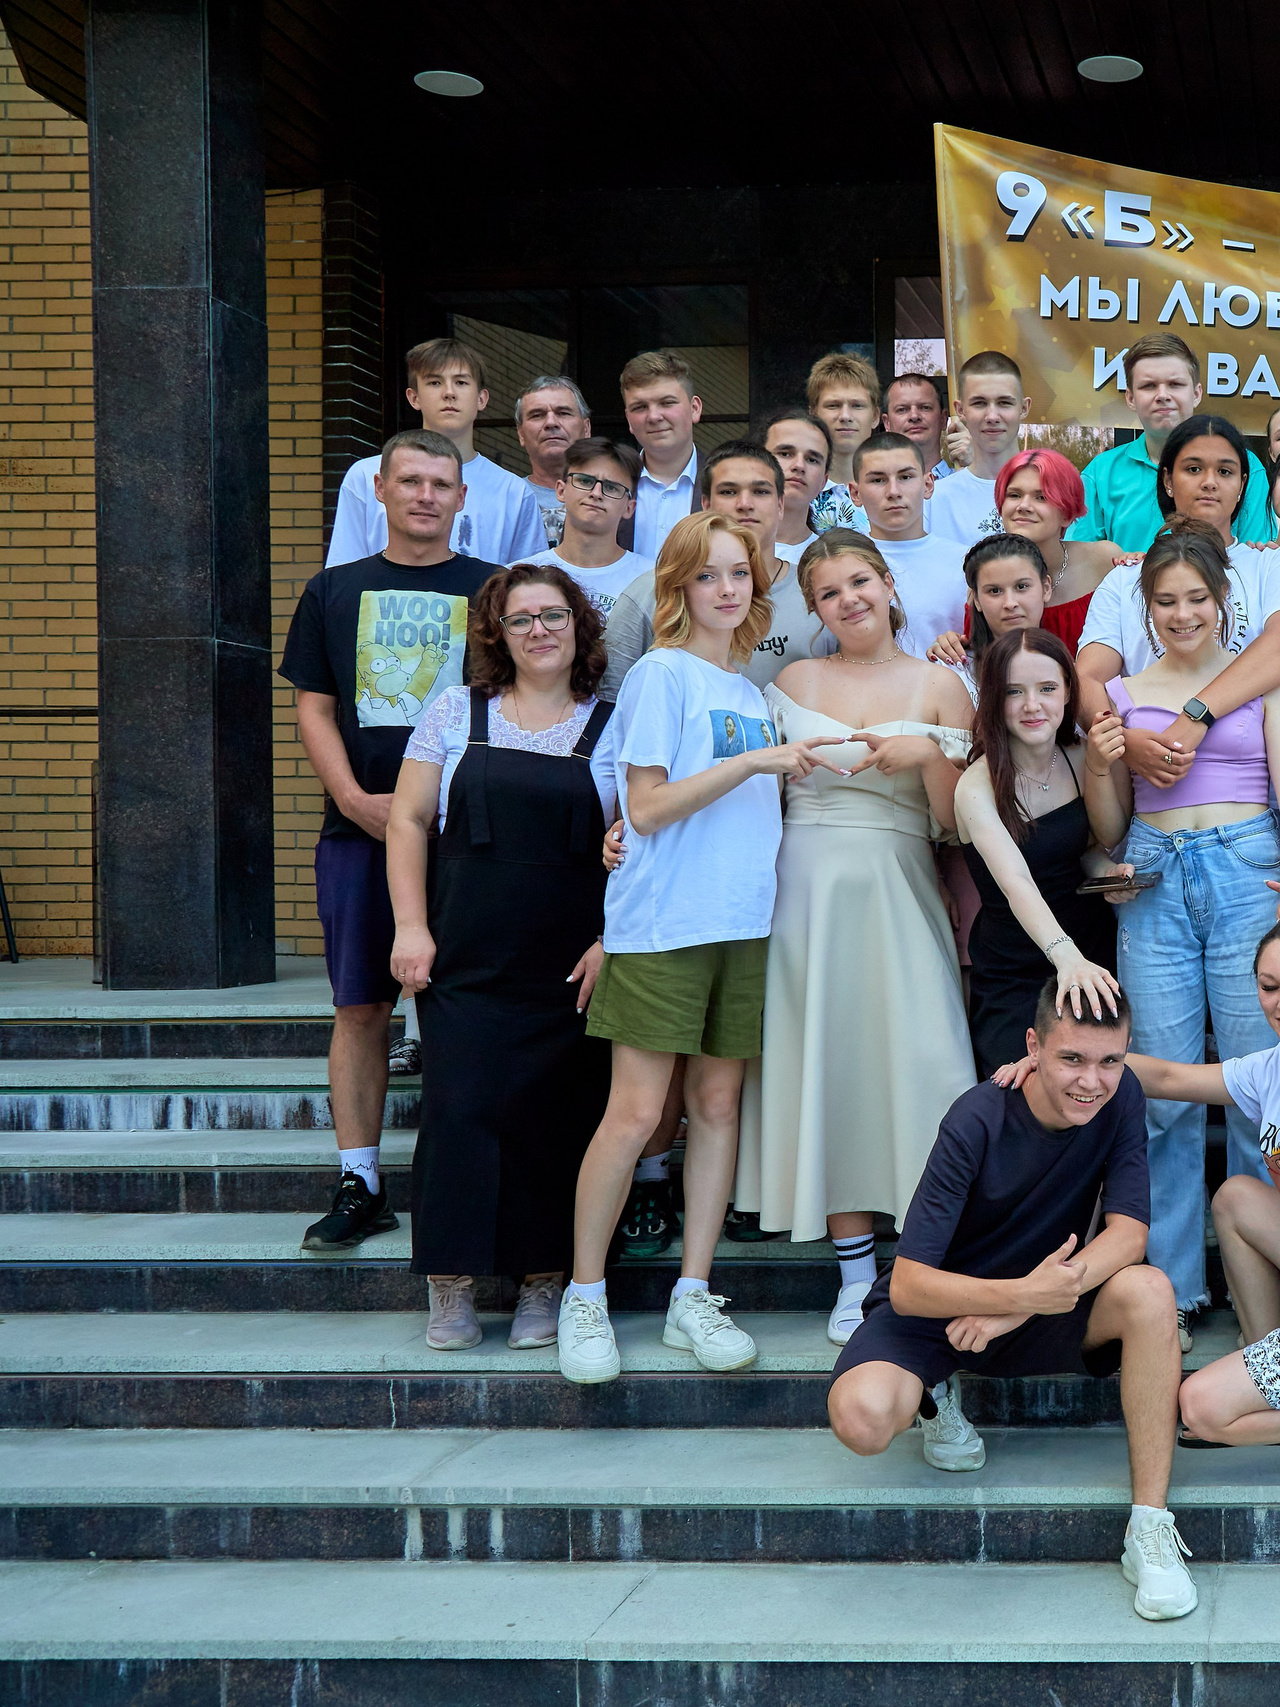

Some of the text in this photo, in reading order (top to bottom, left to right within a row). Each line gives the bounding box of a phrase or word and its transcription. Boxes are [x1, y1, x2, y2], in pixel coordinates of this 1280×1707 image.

[996, 170, 1048, 241] 9
[1060, 189, 1195, 253] «Б»
[1039, 273, 1141, 323] МЫ
[1093, 346, 1130, 392] И
[378, 595, 452, 624] WOO
[375, 621, 450, 651] HOO!
